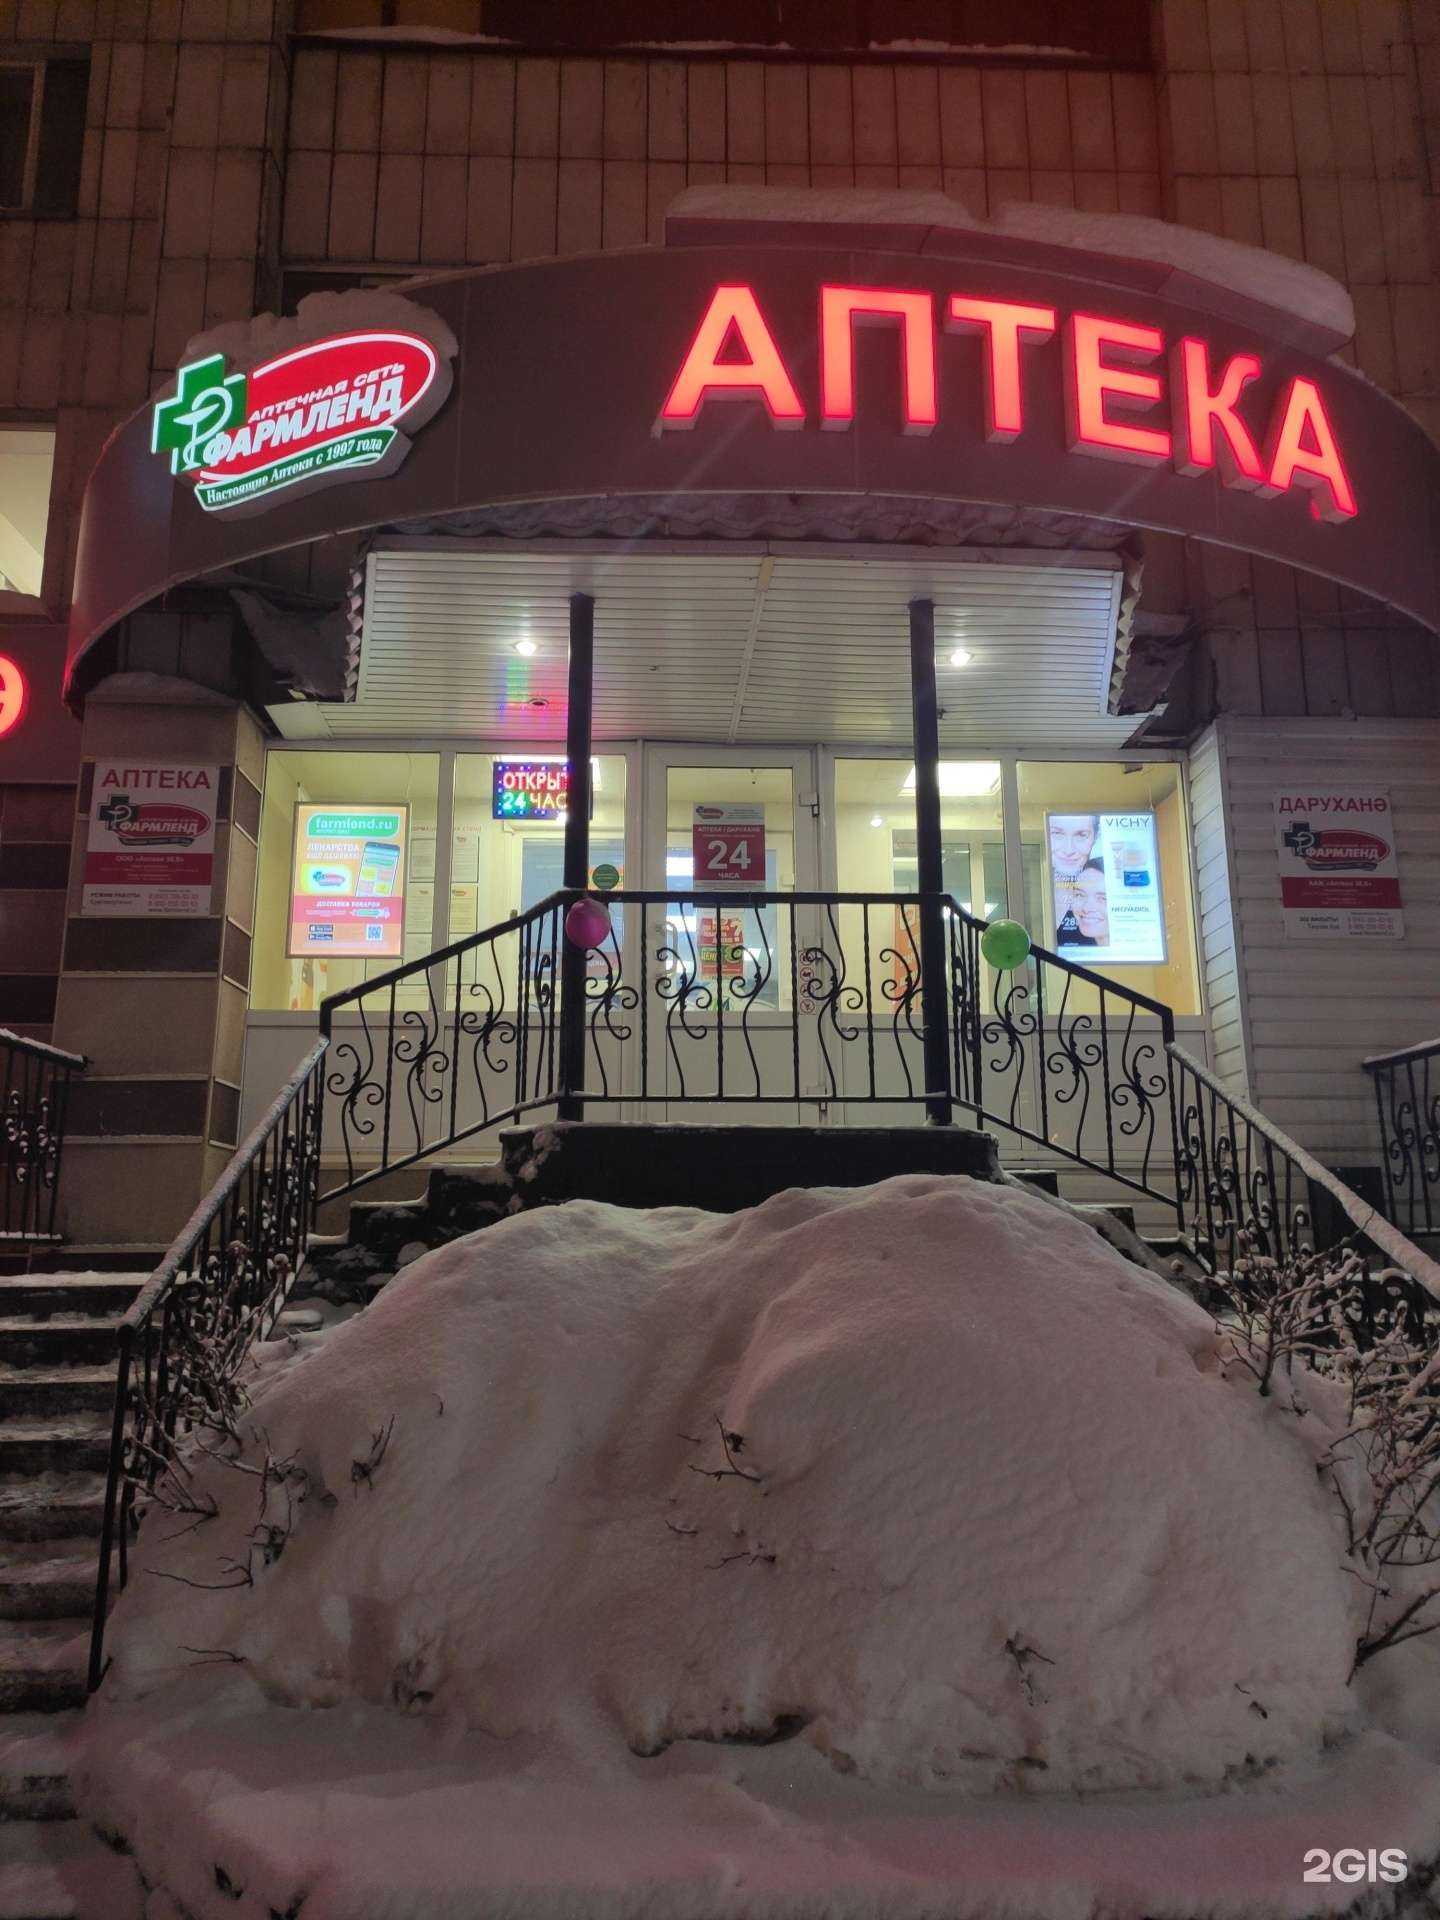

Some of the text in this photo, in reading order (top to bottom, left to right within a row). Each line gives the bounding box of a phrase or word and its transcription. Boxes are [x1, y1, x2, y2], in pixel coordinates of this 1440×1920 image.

[248, 363, 406, 422] АПТЕЧНАЯ СЕТЬ
[662, 284, 1358, 520] АПТЕКА
[201, 375, 404, 466] ФАРМЛЕНД
[206, 476, 269, 504] Настоящие
[270, 454, 314, 483] Аптеки
[325, 439, 355, 463] 1997
[356, 436, 383, 453] года
[101, 768, 211, 790] АПТЕКА
[503, 792, 526, 810] 24
[1279, 797, 1388, 814] ДАРУХАНӘ
[119, 821, 199, 836] ФАРМЛЕНД
[1105, 817, 1150, 828] VICHY
[707, 840, 751, 870] 24
[1306, 847, 1379, 861] ФАРМЛЕНД
